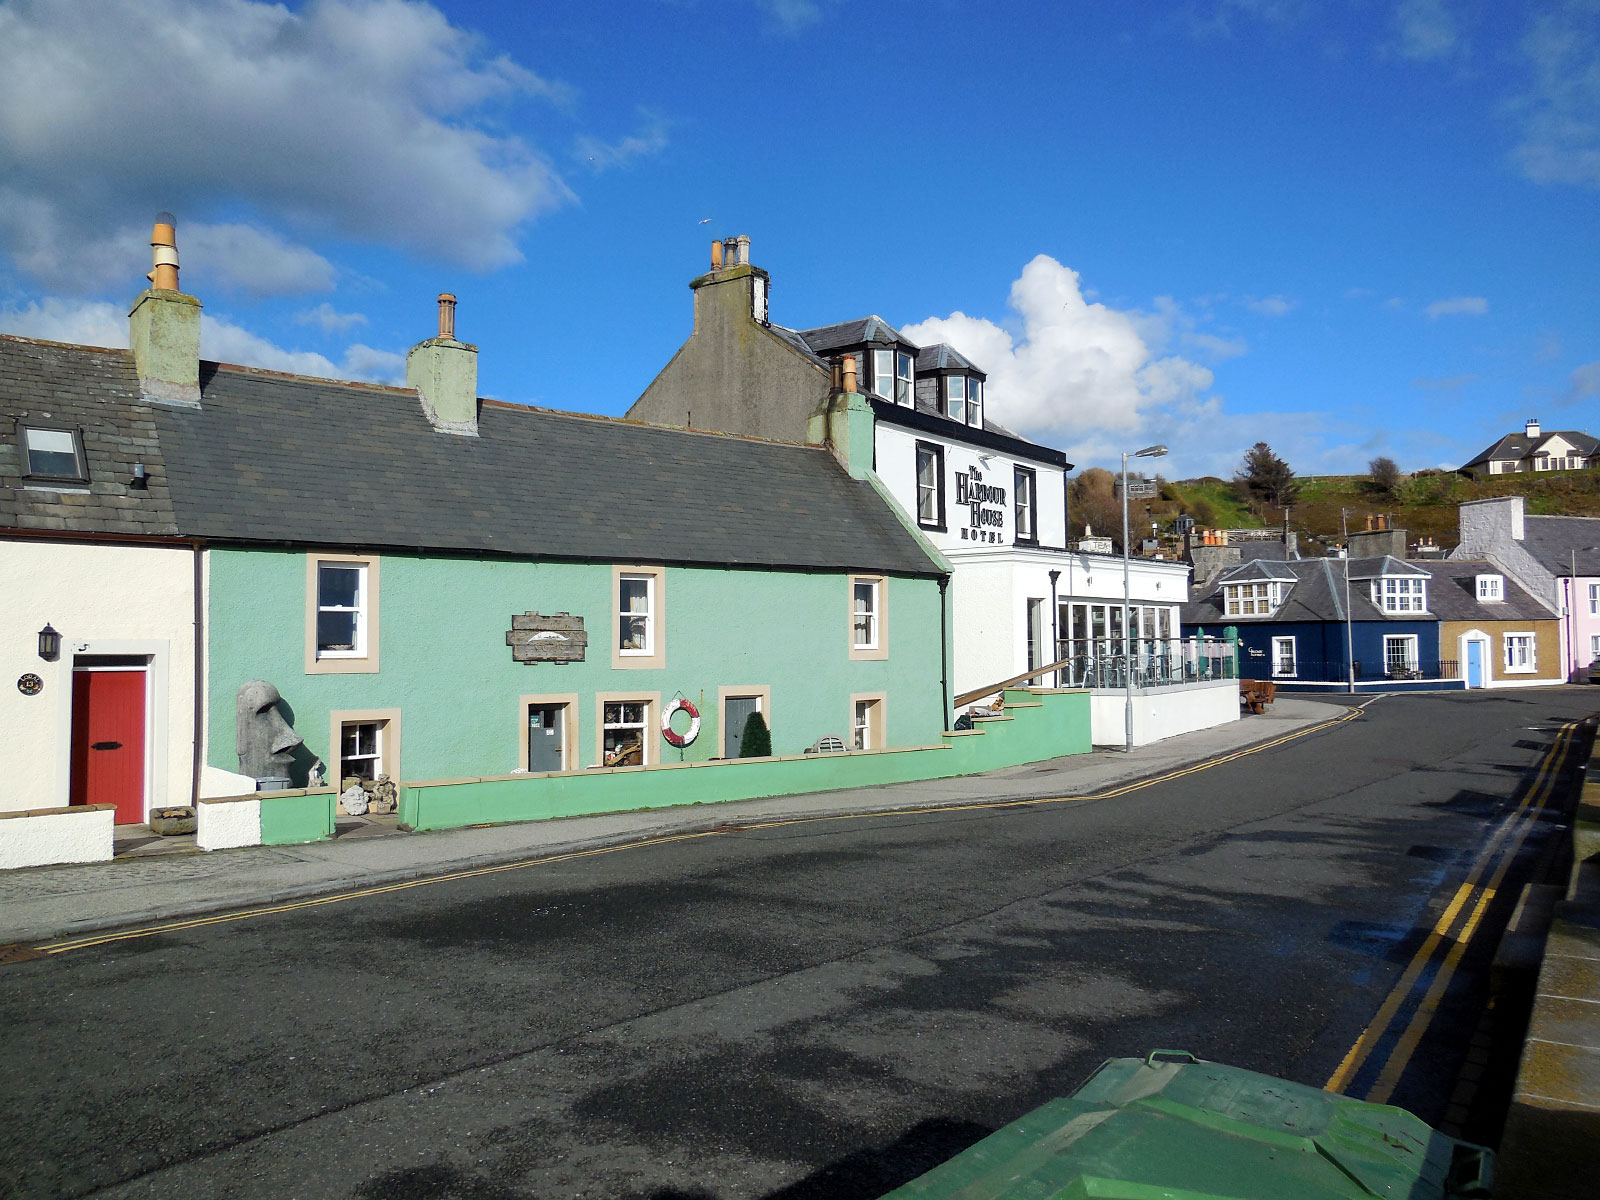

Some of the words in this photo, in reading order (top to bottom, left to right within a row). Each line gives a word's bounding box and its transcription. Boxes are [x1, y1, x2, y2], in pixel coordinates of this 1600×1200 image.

[955, 471, 1007, 507] HARBOUR
[969, 500, 1003, 528] HOUSE
[960, 527, 1004, 544] HOTEL
